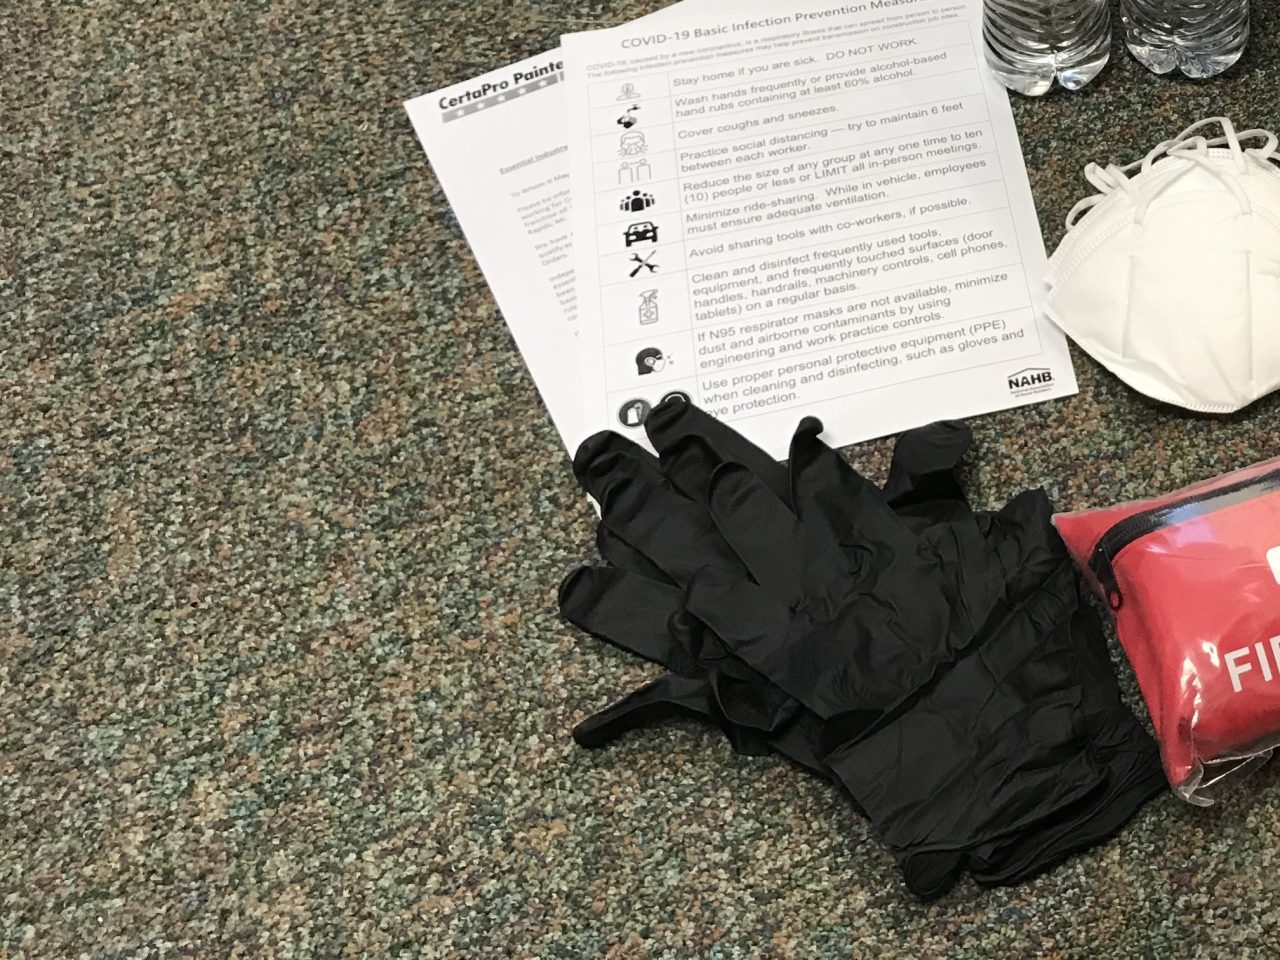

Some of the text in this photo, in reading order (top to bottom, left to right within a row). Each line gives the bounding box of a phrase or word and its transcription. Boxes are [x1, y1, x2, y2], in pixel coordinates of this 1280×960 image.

[620, 29, 690, 49] COVID-19
[693, 24, 728, 38] Basic
[731, 15, 791, 32] Infection
[794, 3, 867, 22] Prevention
[672, 36, 918, 87] Stay home if you are sick. DO NOT WORK.
[439, 80, 509, 110] CertaPro
[677, 105, 839, 139] Cover coughs and sneezes.
[682, 129, 983, 192] Reduce the size of any group at any one time to ten
[685, 159, 987, 223] Minimize ride-sharing. While in vehicle, employees
[686, 190, 889, 234] must ensure adequate ventilation.
[688, 197, 971, 258] Avoid sharing tools with co-workers, if possible.
[697, 272, 1008, 342] If N95 respirator masks are not available, minimize
[697, 296, 951, 356] dust and airborne contaminants by using
[699, 311, 945, 369] engineering and work practice controls.
[731, 391, 800, 415] protection.
[1008, 371, 1052, 389] NAHB
